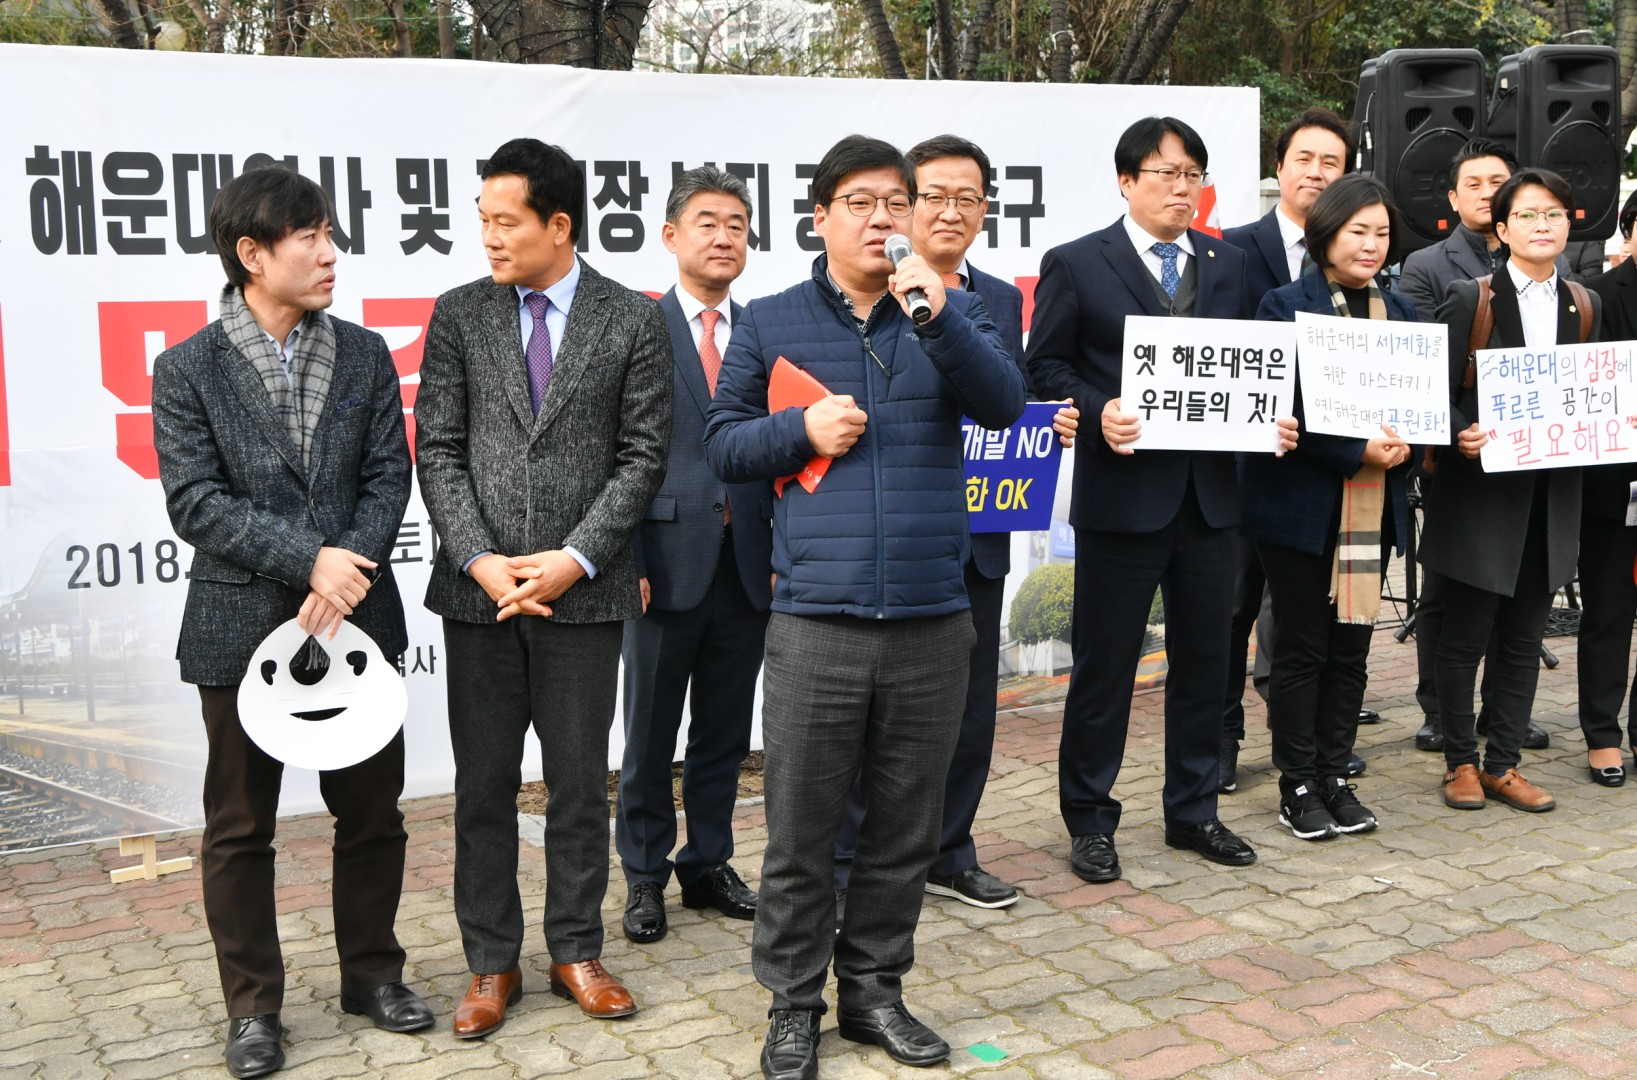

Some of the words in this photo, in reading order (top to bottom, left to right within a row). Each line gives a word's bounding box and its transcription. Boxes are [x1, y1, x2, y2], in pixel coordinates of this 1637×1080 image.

[25, 145, 372, 256] 해운대사
[396, 158, 454, 256] 및
[984, 165, 1046, 249] 구
[1306, 326, 1369, 354] 해운대의
[1376, 332, 1443, 359] 세계화를
[1133, 344, 1156, 376] 옛
[1172, 345, 1287, 380] 해운대역은
[1323, 365, 1347, 386] 위한
[1499, 350, 1578, 385] 해운대의
[1583, 346, 1633, 384] 심장에
[1138, 388, 1230, 423] 우리들의
[1247, 392, 1278, 424] 것!
[1490, 390, 1545, 421] 푸르른
[1561, 384, 1619, 416] 공간이
[1015, 426, 1054, 459] NO
[995, 478, 1034, 510] OK
